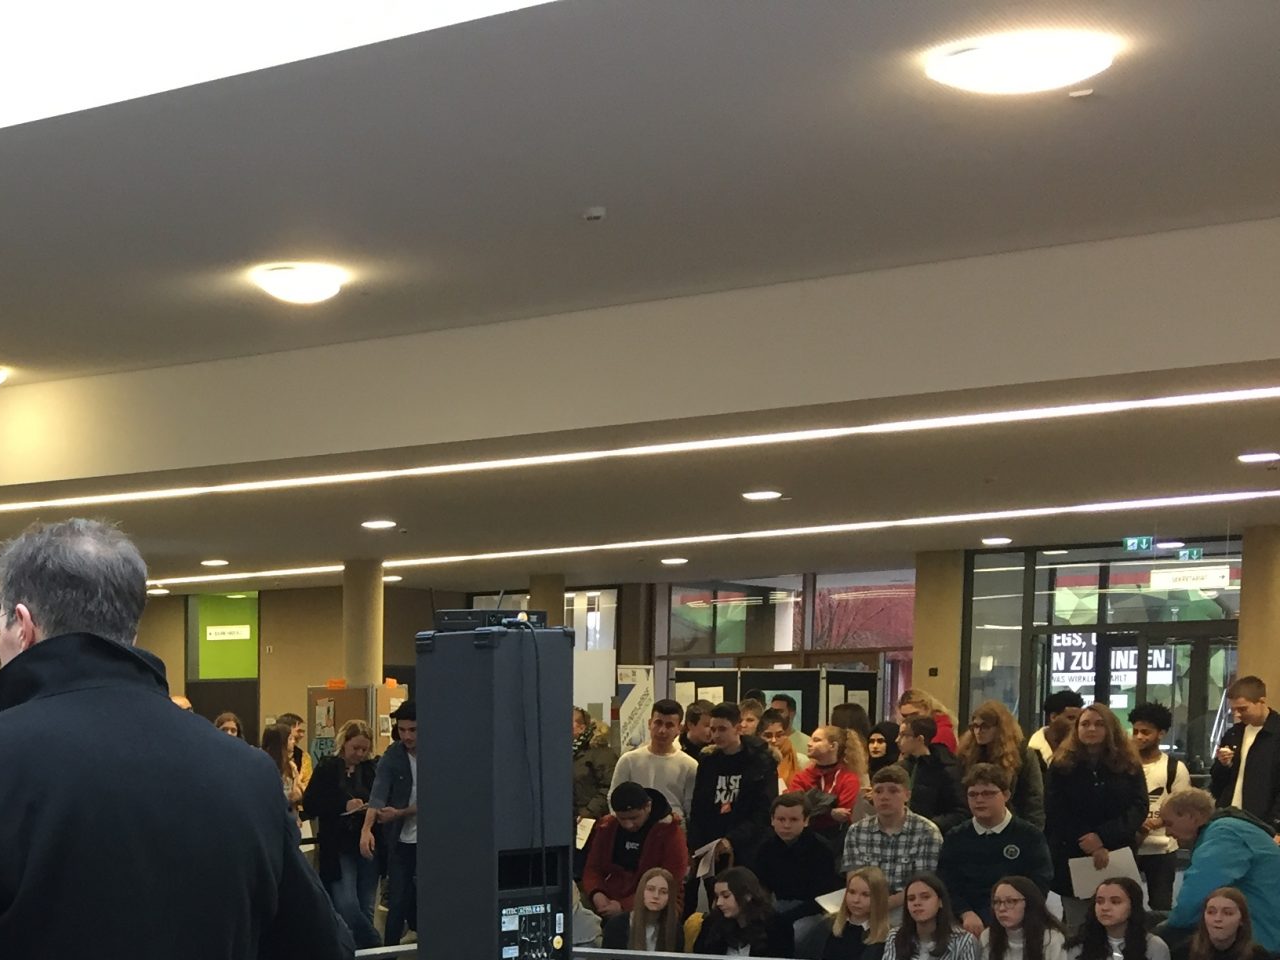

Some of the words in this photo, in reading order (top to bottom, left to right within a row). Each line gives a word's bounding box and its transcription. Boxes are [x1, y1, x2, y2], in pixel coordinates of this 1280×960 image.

[1052, 632, 1087, 647] EGS,
[1070, 651, 1094, 670] ZU
[1110, 649, 1171, 670] INDEN.
[1068, 674, 1096, 683] WIRKLI
